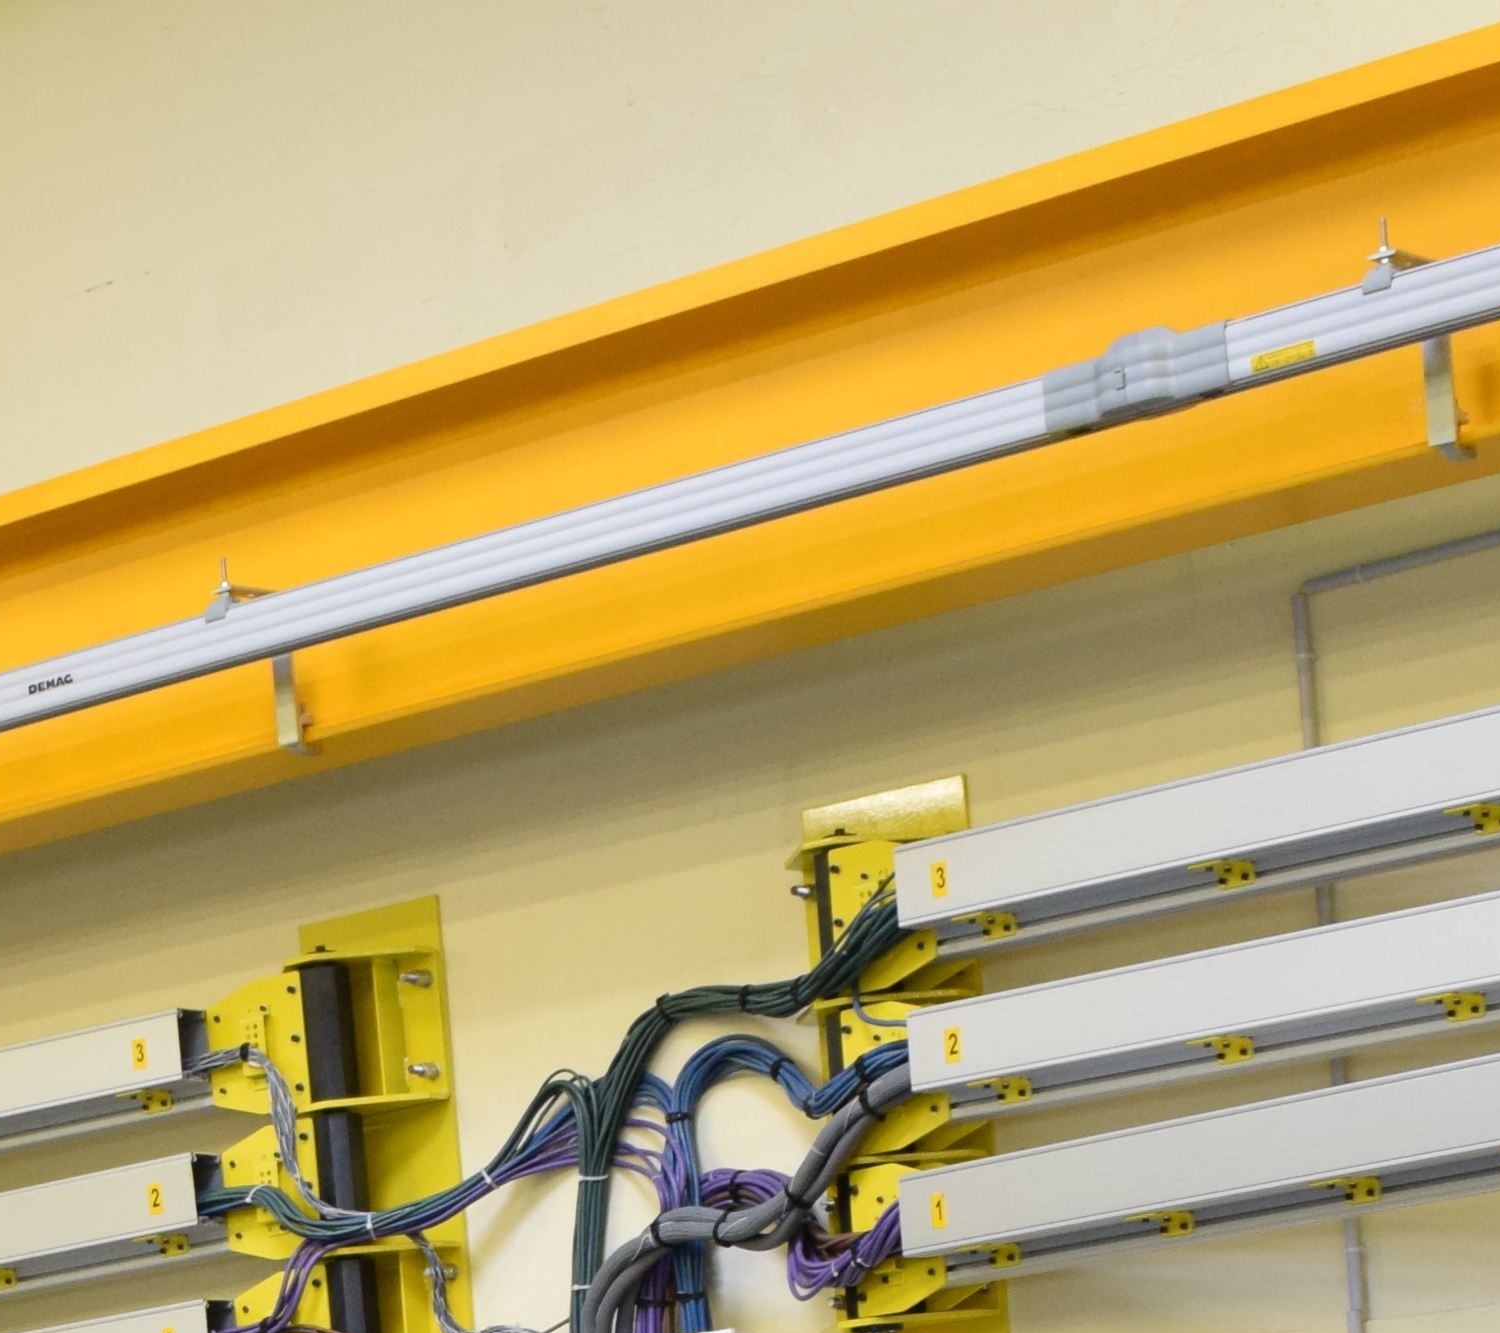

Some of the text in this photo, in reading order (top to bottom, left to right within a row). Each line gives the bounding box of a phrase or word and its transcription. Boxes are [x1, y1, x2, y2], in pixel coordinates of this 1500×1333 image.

[936, 867, 947, 889] 3
[136, 1042, 146, 1062] 3
[949, 1033, 960, 1056] 2
[150, 1188, 161, 1208] 2
[936, 1198, 944, 1222] 1
